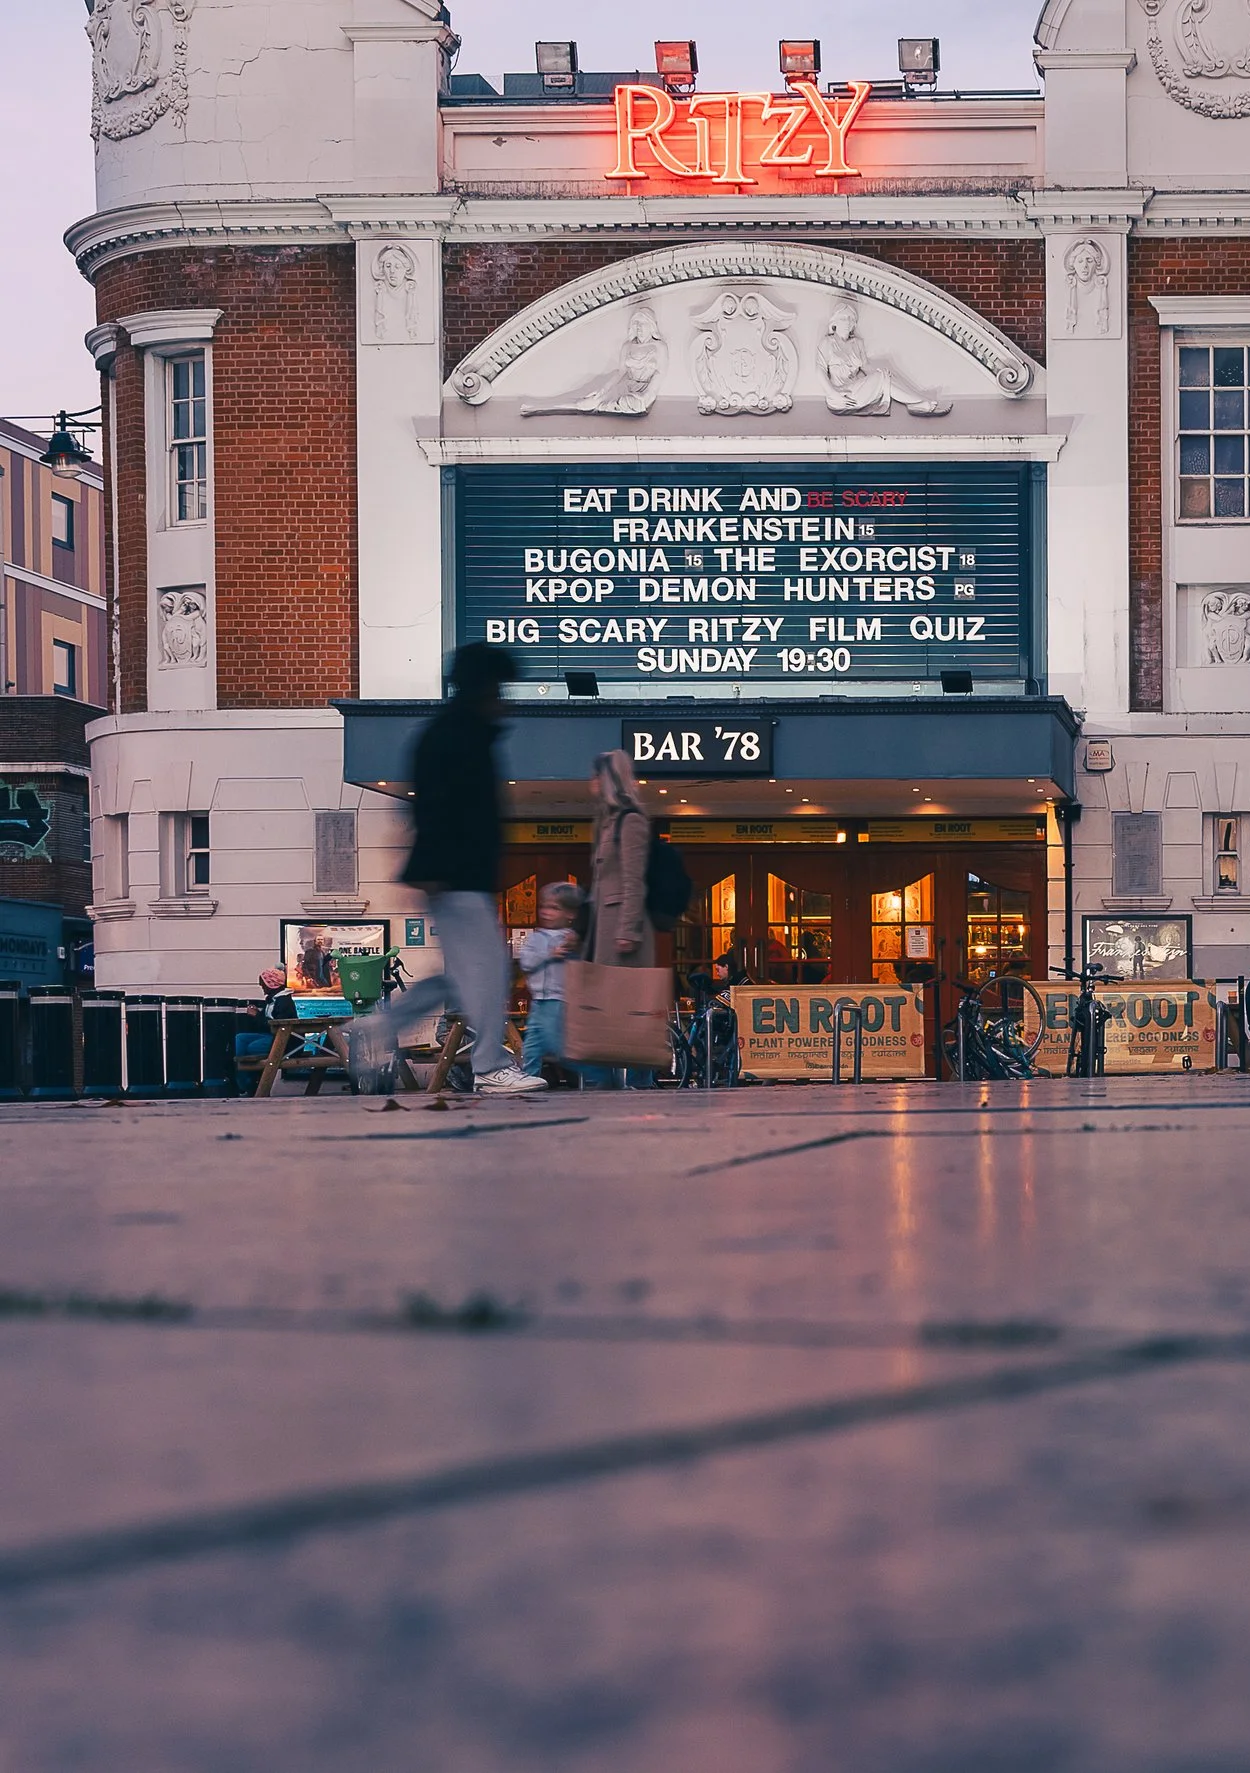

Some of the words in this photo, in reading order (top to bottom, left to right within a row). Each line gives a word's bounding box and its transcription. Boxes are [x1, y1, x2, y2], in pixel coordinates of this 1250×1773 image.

[564, 489, 617, 512] EAT
[629, 488, 723, 511] DRINK
[739, 488, 801, 511] AND
[807, 491, 833, 508] BE
[843, 491, 908, 508] SCARY
[614, 518, 854, 542] FRANKENSTEIN
[859, 523, 875, 537] 15
[525, 549, 670, 572] BUGONIA
[686, 554, 702, 568] 15
[714, 548, 775, 571] THE
[800, 547, 955, 571] EXORCIST
[959, 554, 975, 567] 18
[525, 579, 614, 602] KPOP
[640, 579, 756, 602] DEMON
[784, 576, 935, 602] HUNTERS
[955, 582, 974, 597] PG
[487, 620, 540, 643] BIG
[558, 618, 667, 643] SCARY
[689, 618, 784, 642] RITZY
[810, 618, 882, 642] FILM
[911, 616, 985, 641] QUIZ
[637, 648, 758, 673] SUNDAY
[776, 648, 850, 672] 19:30
[633, 732, 703, 761] BAR
[714, 727, 761, 761] '78
[736, 825, 749, 834] EN
[750, 824, 773, 834] ROOT
[752, 997, 800, 1034] EN
[750, 1038, 784, 1048] PLANT
[788, 1037, 841, 1048] POWERE
